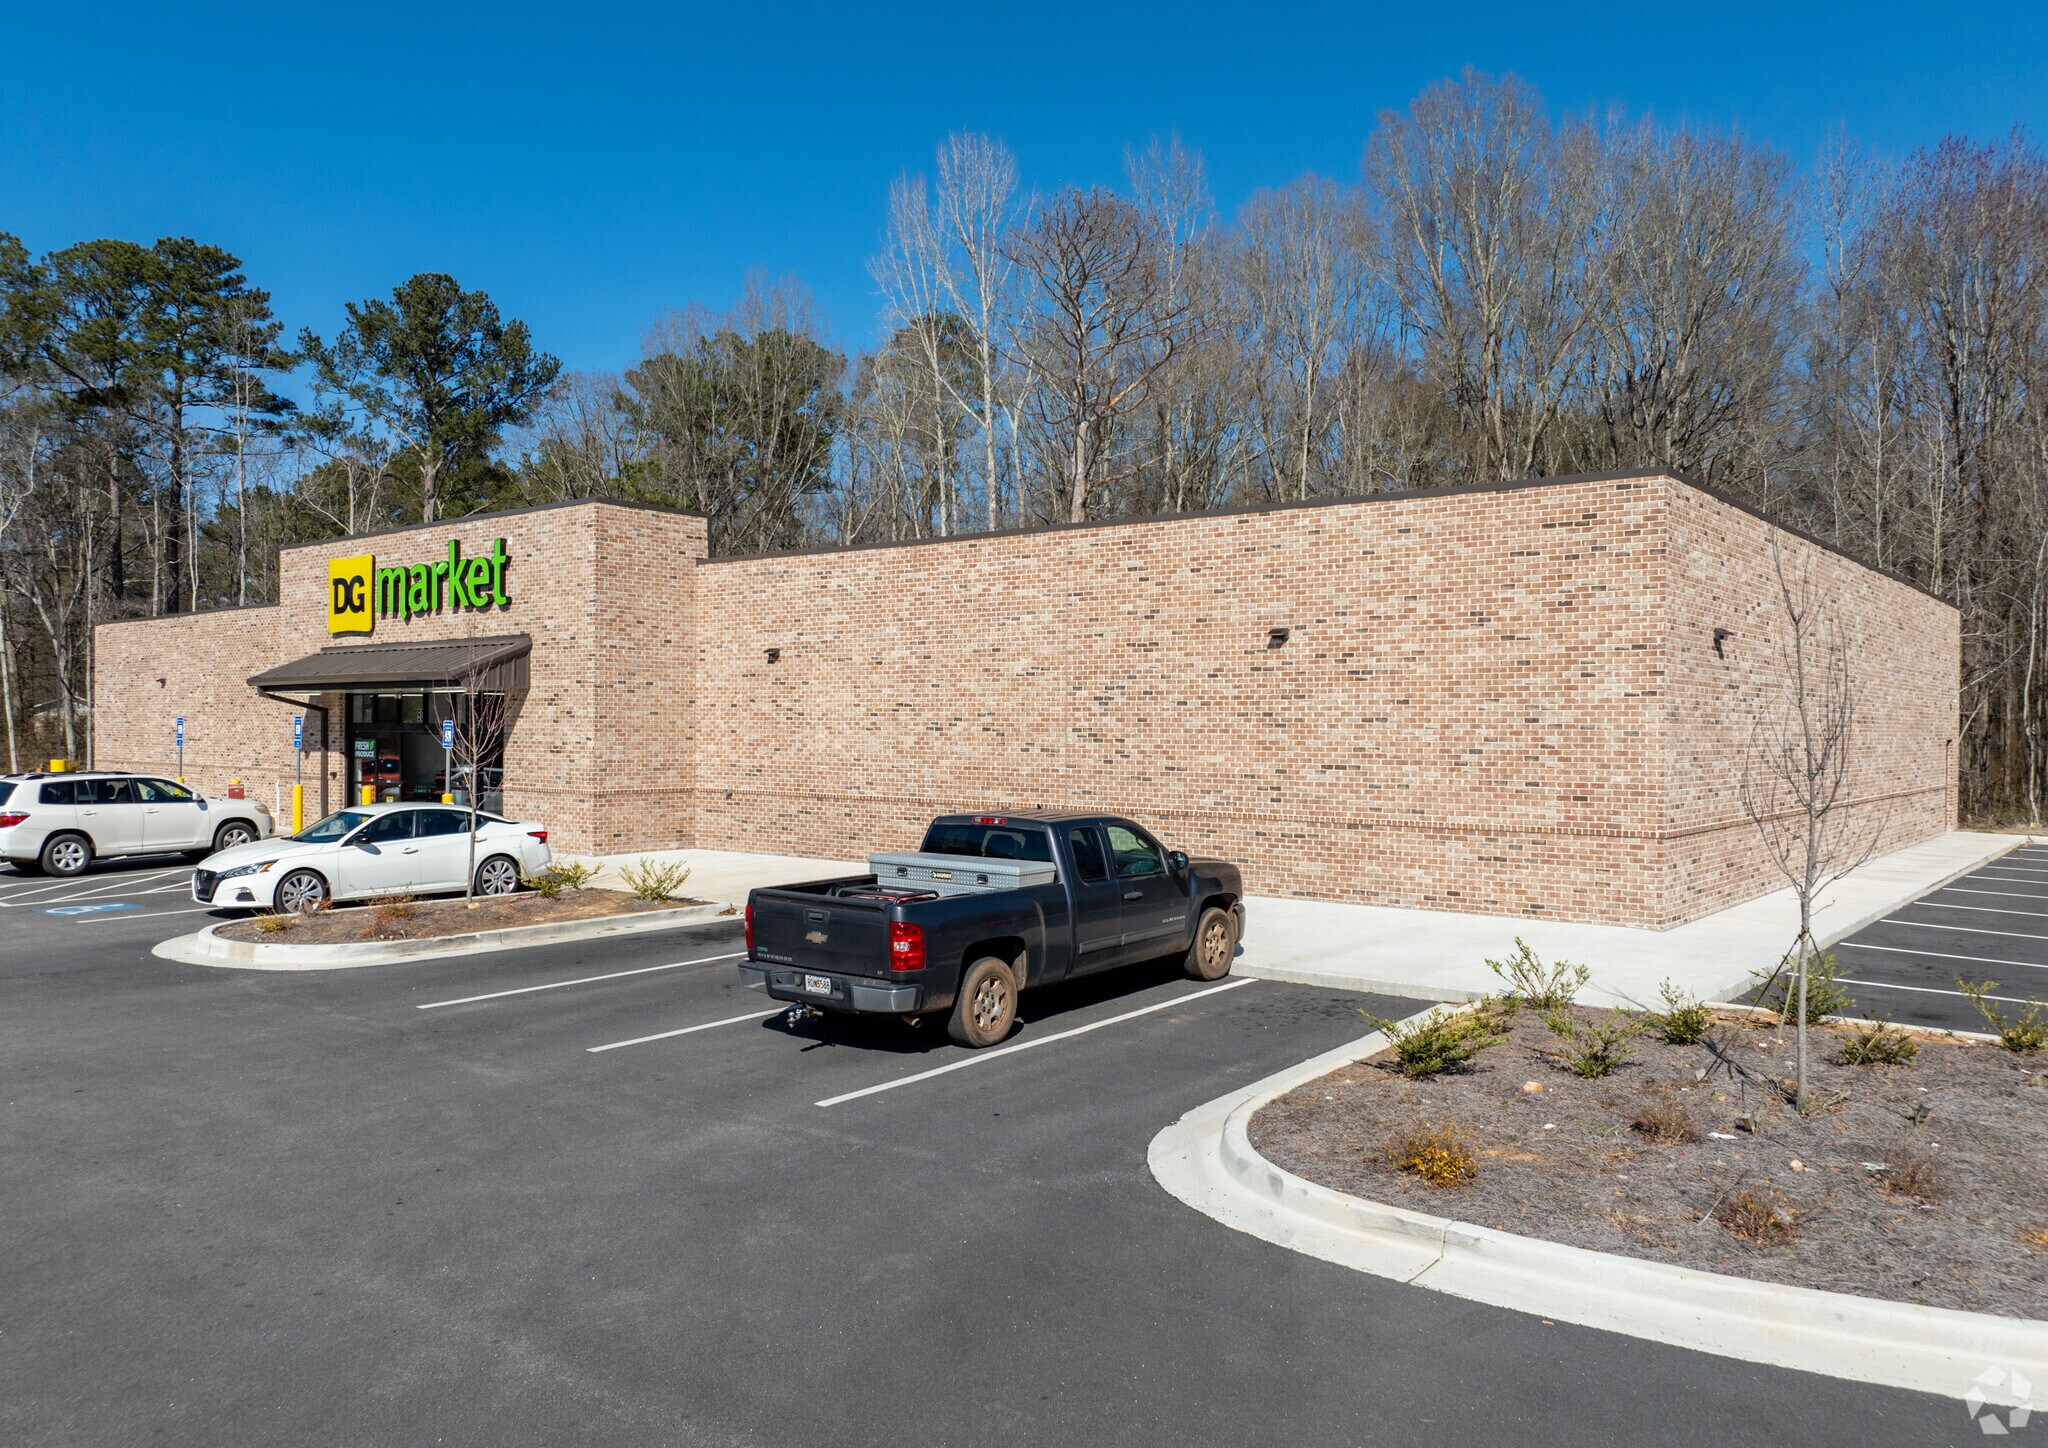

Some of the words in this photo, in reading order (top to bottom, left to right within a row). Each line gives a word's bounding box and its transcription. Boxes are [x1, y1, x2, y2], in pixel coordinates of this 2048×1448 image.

[332, 575, 365, 615] DG
[377, 537, 508, 619] market
[354, 741, 370, 751] FRESH
[354, 750, 375, 758] PRODUCE
[756, 952, 793, 962] SILVERADO
